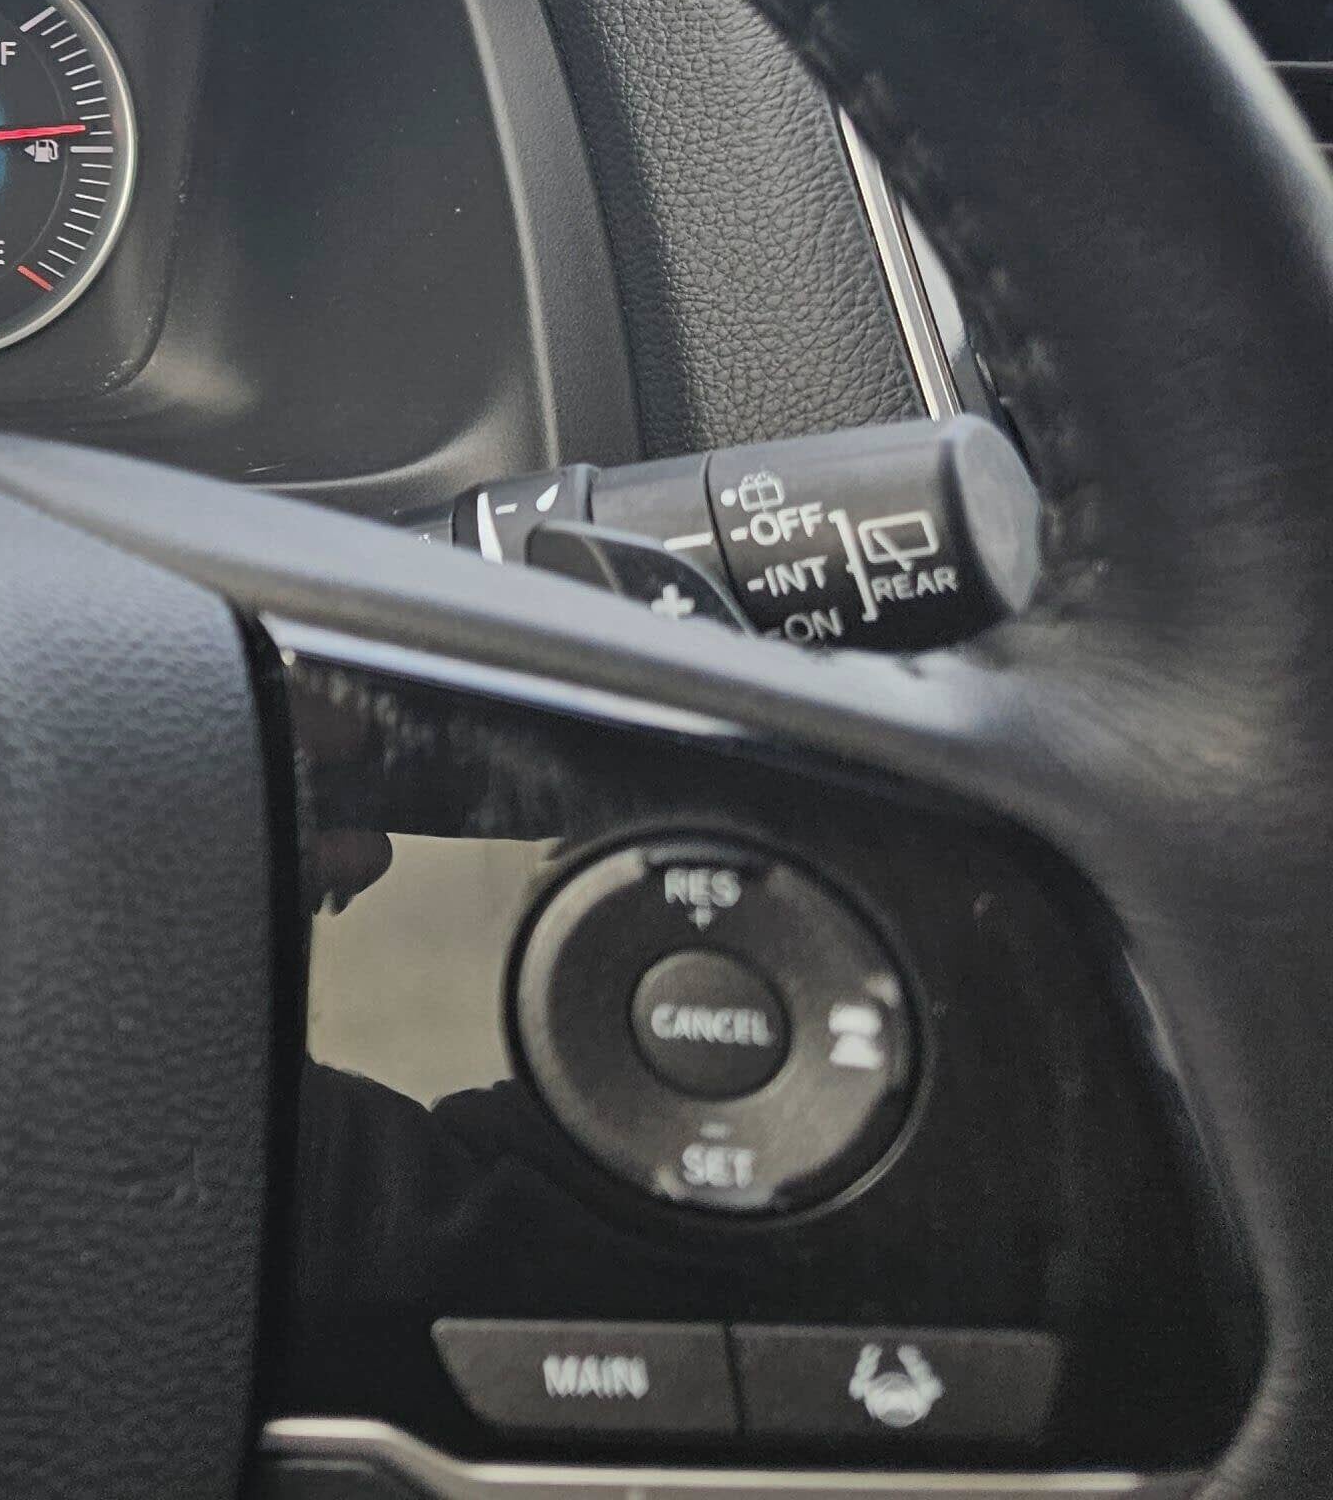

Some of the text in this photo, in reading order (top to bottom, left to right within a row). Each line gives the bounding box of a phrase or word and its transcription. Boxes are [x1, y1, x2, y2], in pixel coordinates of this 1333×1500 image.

[0, 41, 17, 66] F
[749, 501, 824, 546] OFF
[764, 555, 829, 598] INT
[870, 565, 958, 603] REAR
[784, 606, 843, 642] ON
[663, 868, 743, 908] RES
[650, 1002, 773, 1047] CANCEL
[681, 1142, 755, 1189] SET
[542, 1354, 650, 1401] MAIN
